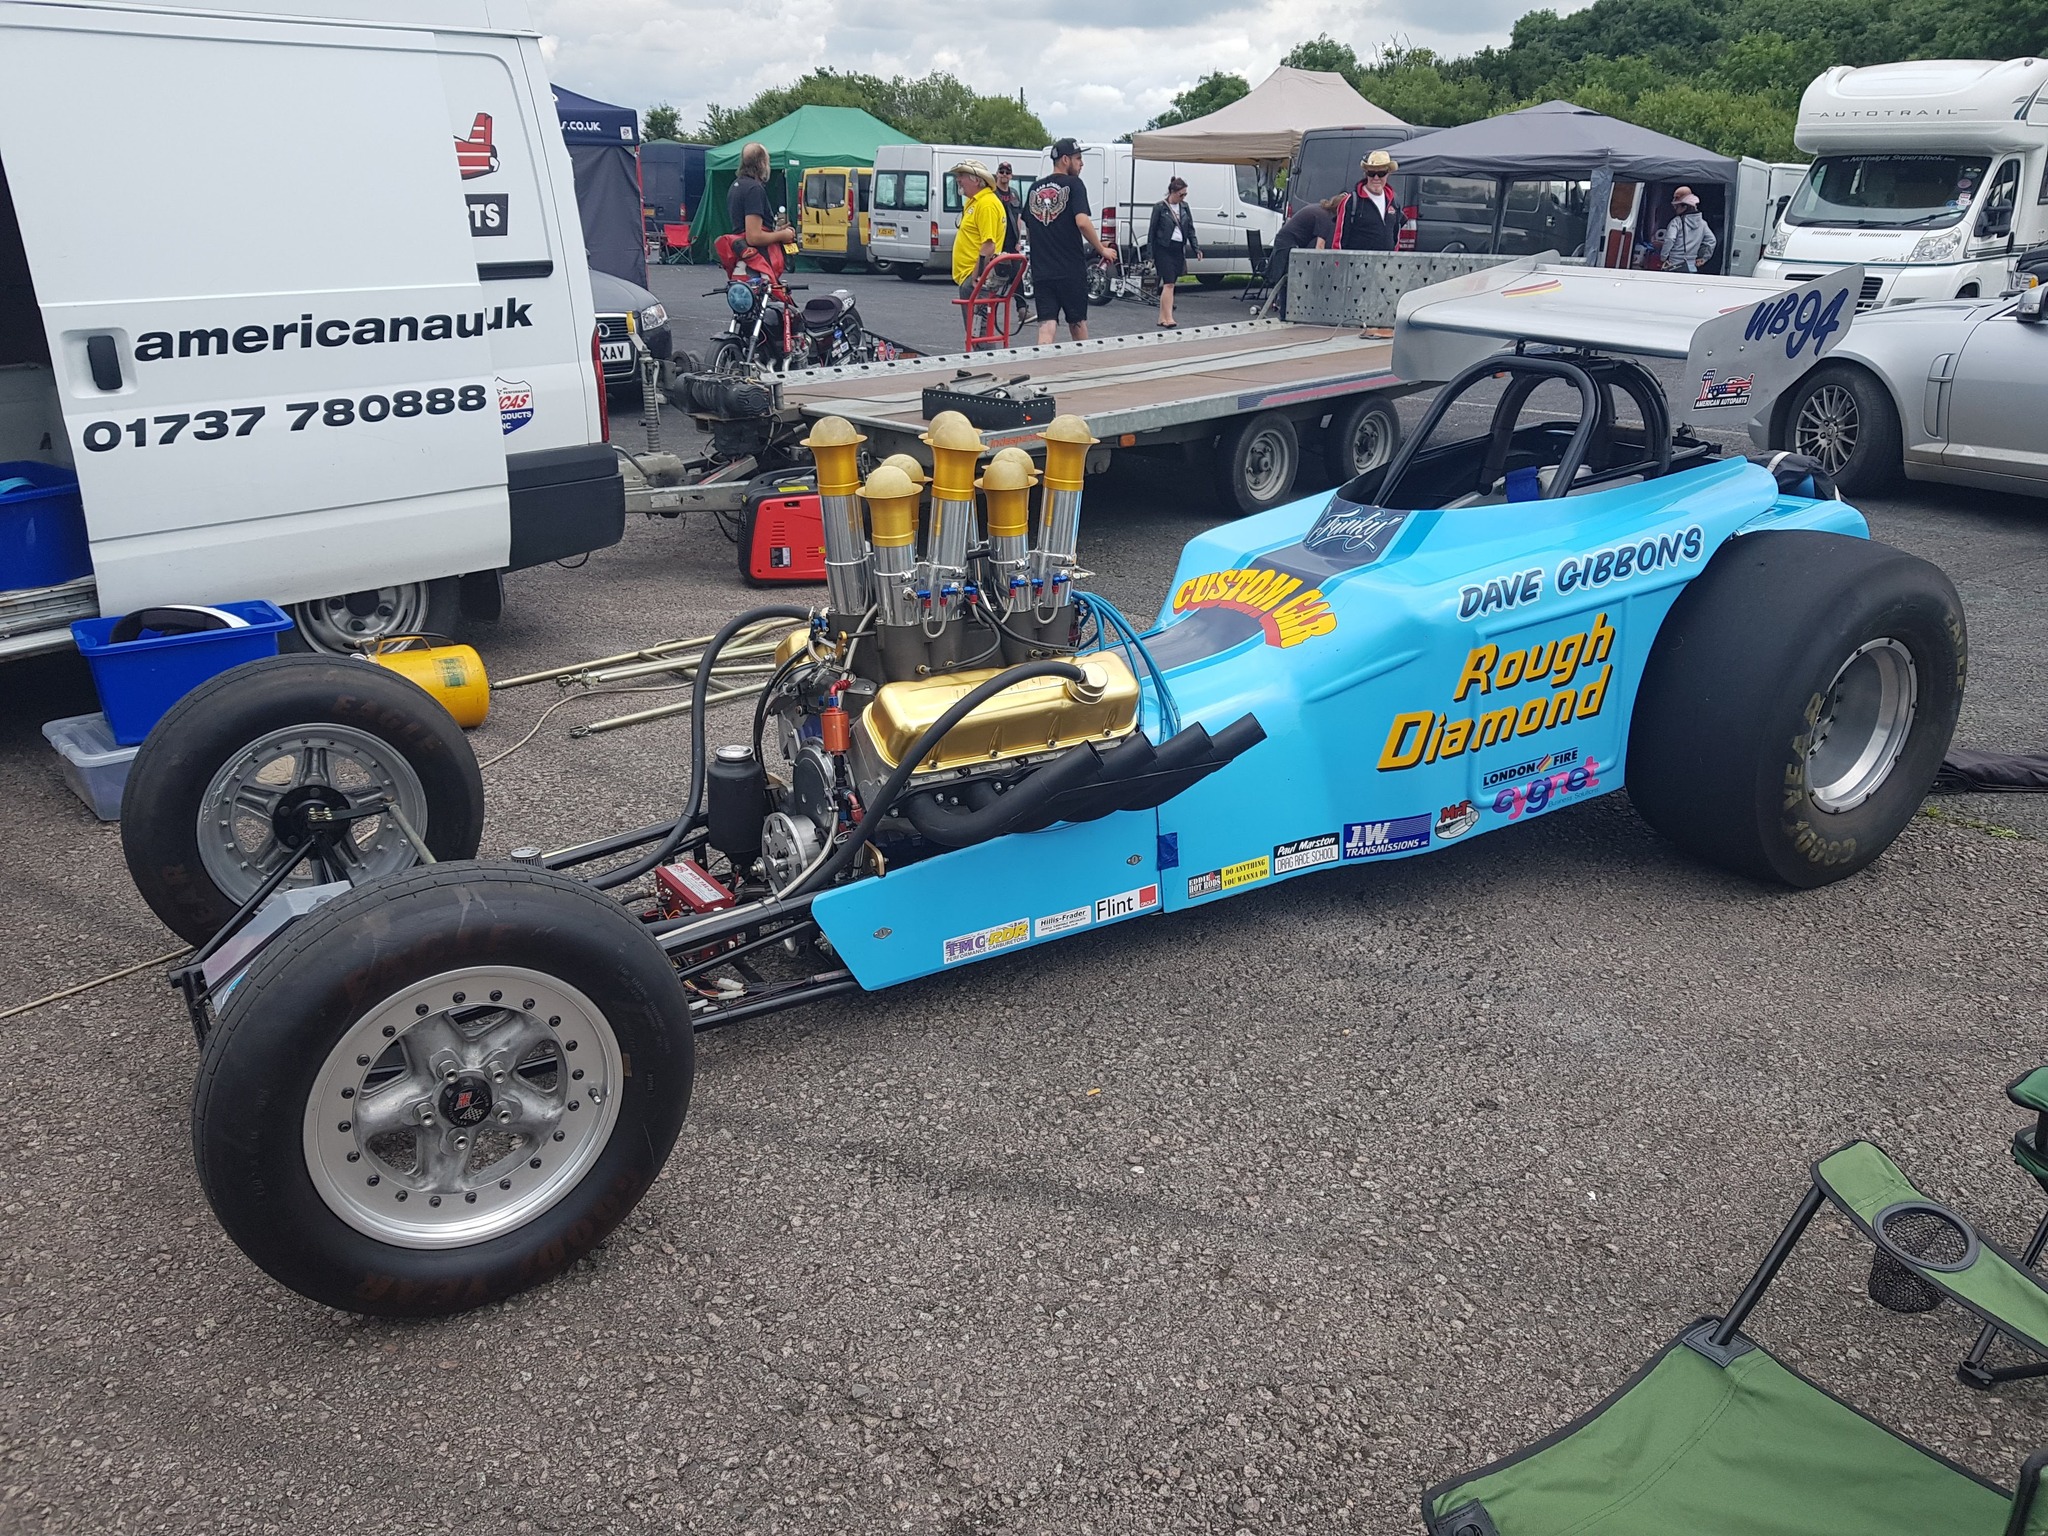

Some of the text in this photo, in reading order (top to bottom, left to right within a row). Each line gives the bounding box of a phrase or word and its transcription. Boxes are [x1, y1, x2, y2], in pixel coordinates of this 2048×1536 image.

[1819, 108, 1958, 118] AUTOTRAIL
[1744, 287, 1849, 360] WB94
[1694, 399, 1719, 409] AMERICAN
[83, 383, 488, 453] 01737 780888
[1457, 525, 1705, 620] DAVE GIBBONS
[1172, 569, 1338, 649] CUSTOM CAR
[1453, 612, 1616, 702] Rough
[1376, 663, 1614, 772] Diamond
[1483, 749, 1579, 787] LONDON FIRE
[1491, 755, 1600, 821] cygnet
[1277, 836, 1336, 857] Paul Marston
[1277, 846, 1336, 872] DRAG RACE SCHOOL
[1346, 838, 1419, 858] TRANSMISSIONS
[1223, 877, 1236, 887] YOU
[1236, 870, 1259, 884] WANNA
[1258, 868, 1268, 878] DO
[1225, 858, 1266, 876] DO ANYTHING
[1188, 875, 1211, 886] EDDIE
[1188, 883, 1203, 894] HOT
[1203, 879, 1221, 889] RODS
[1096, 895, 1134, 921] Flint
[1140, 899, 1156, 908] GROUP
[1040, 910, 1087, 926] Hillis-Frader
[945, 935, 1028, 963] PERFORMANCE CARBURETORS
